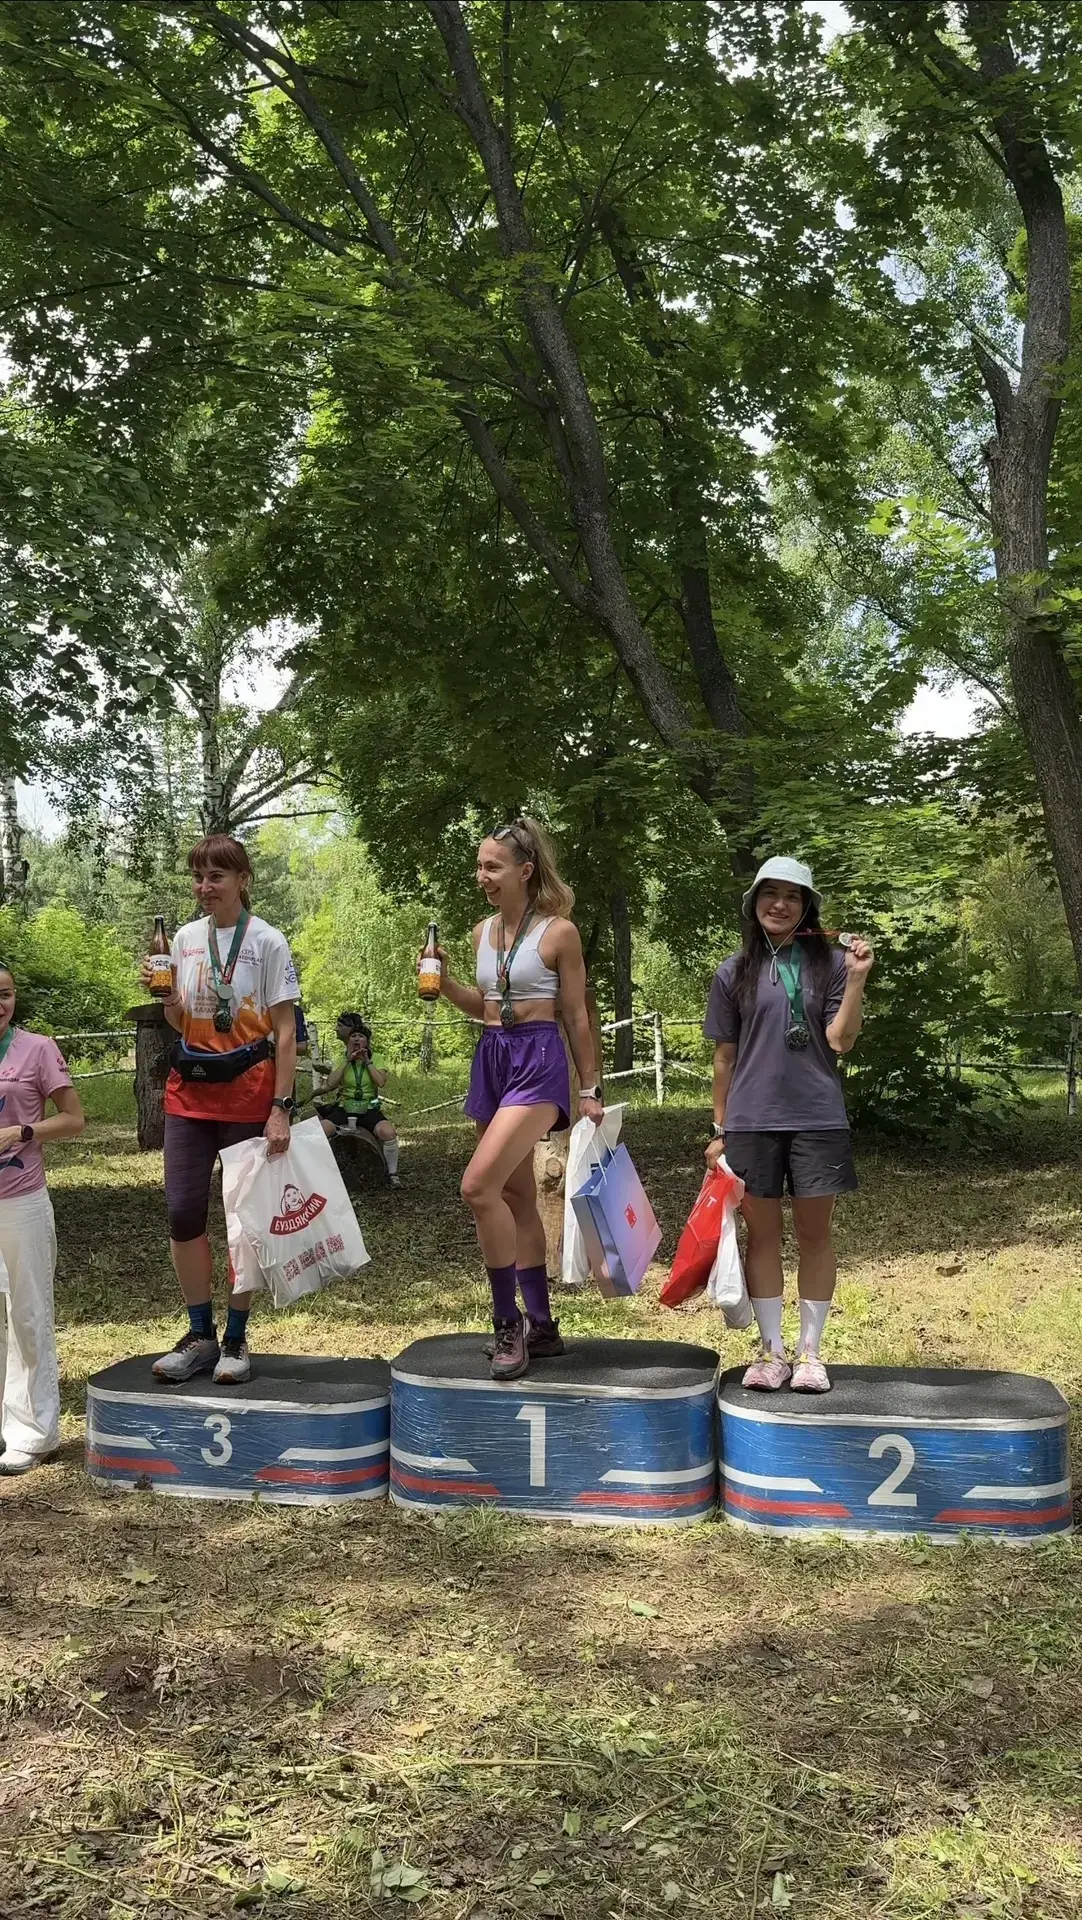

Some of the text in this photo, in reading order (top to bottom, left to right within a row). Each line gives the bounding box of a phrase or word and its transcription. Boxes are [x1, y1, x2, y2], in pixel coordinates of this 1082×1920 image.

[201, 1413, 232, 1466] 3
[515, 1404, 546, 1487] 1
[867, 1433, 918, 1507] 2
